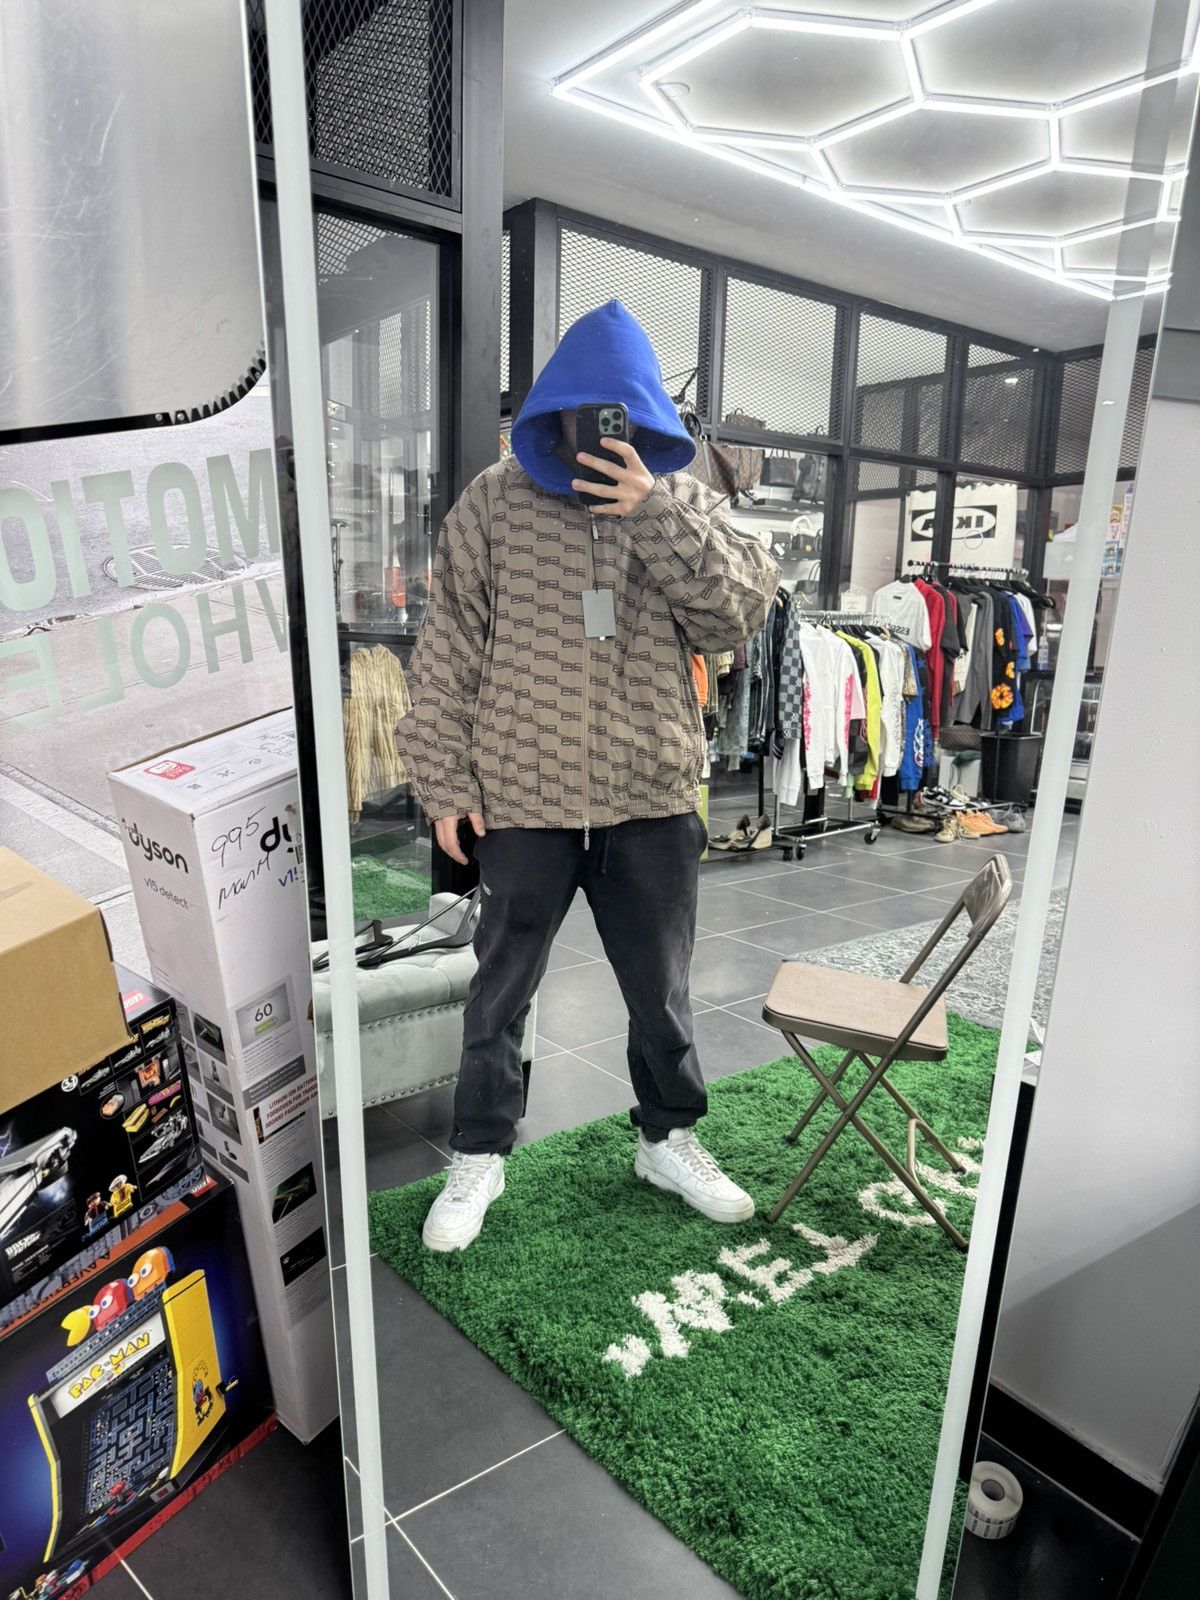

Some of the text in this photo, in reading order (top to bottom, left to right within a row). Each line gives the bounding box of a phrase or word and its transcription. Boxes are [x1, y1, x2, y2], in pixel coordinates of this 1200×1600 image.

[128, 820, 189, 874] dyson
[211, 806, 266, 867] 995
[254, 1004, 273, 1022] 60
[68, 1331, 152, 1400] PAC-MAN
